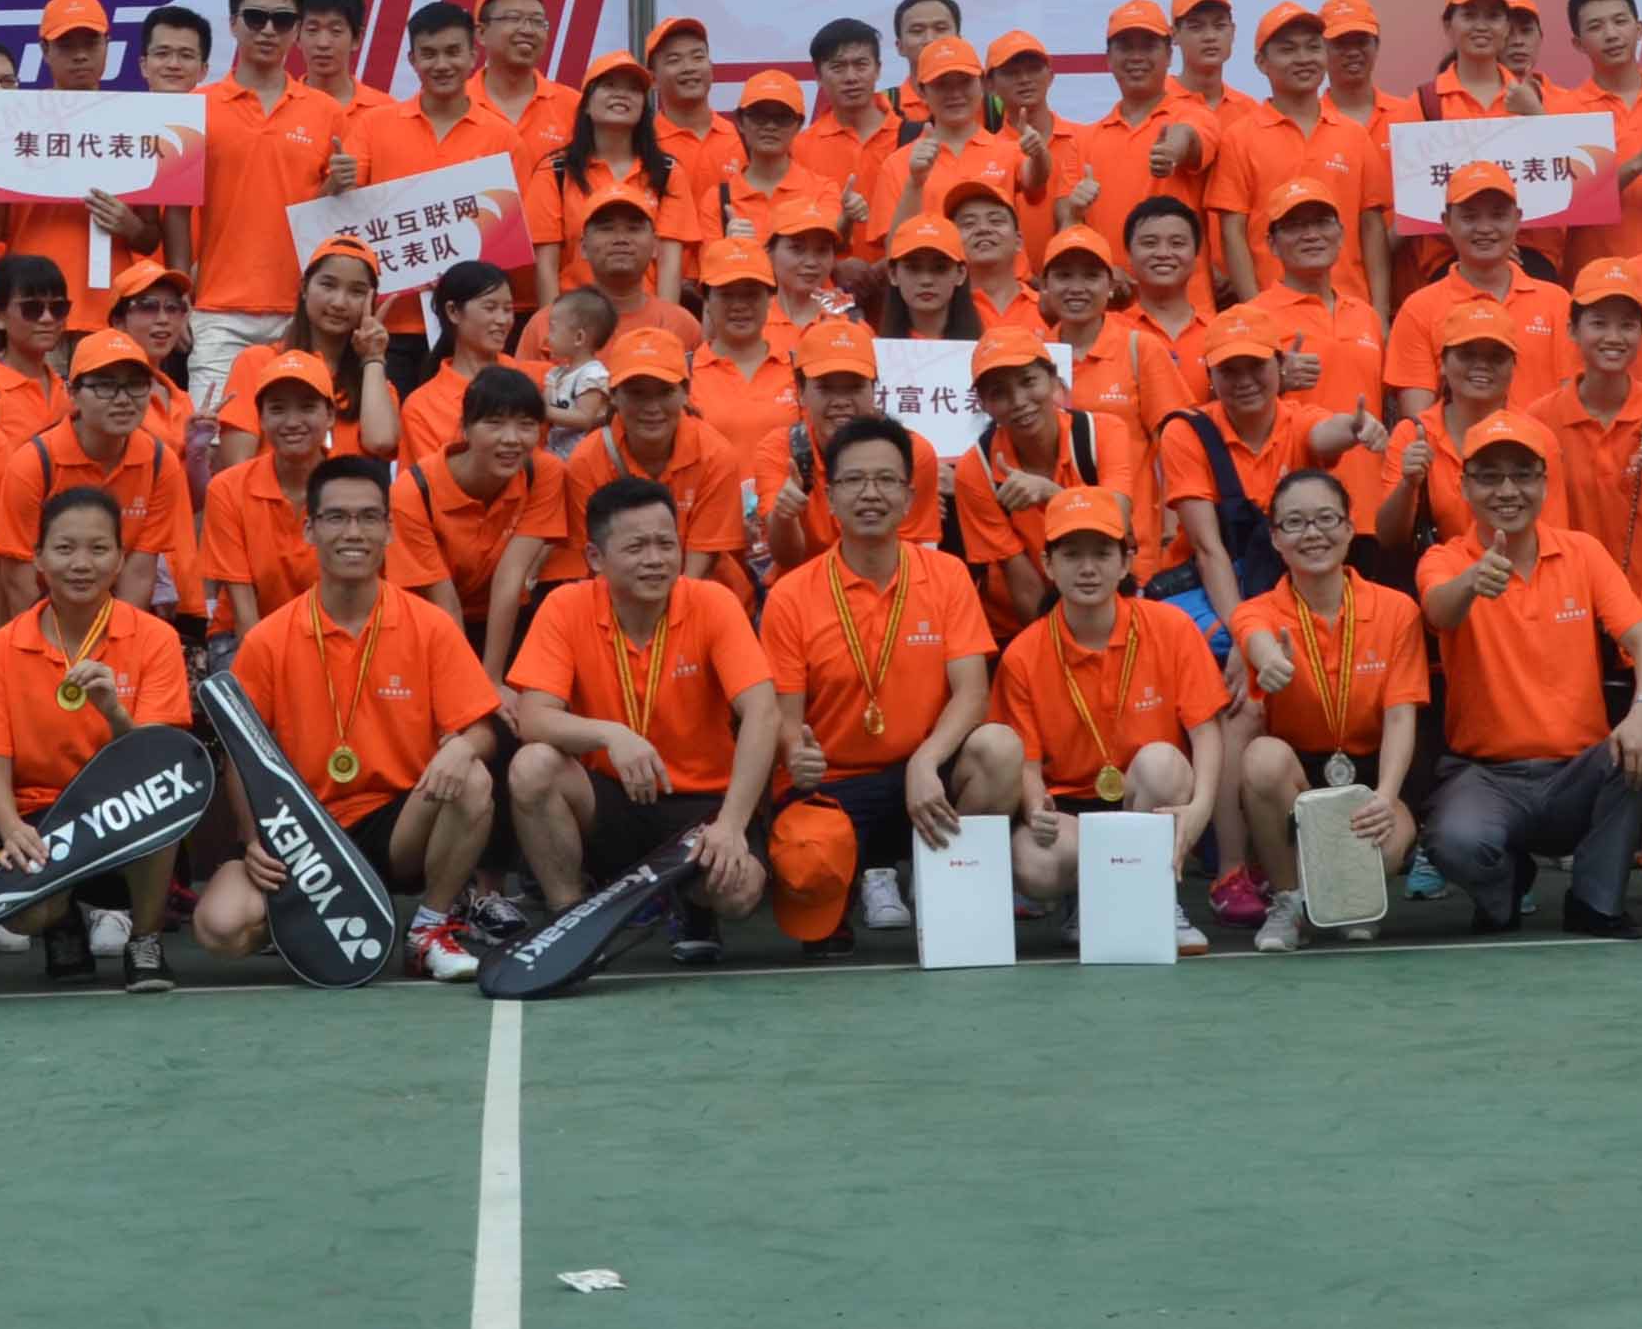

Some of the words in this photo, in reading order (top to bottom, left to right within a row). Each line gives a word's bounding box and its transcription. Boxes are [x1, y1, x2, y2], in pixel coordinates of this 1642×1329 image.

[13, 130, 166, 159] 集团代表队
[375, 233, 460, 276] 代表队
[79, 761, 196, 840] YONEX
[259, 804, 344, 916] YONEX
